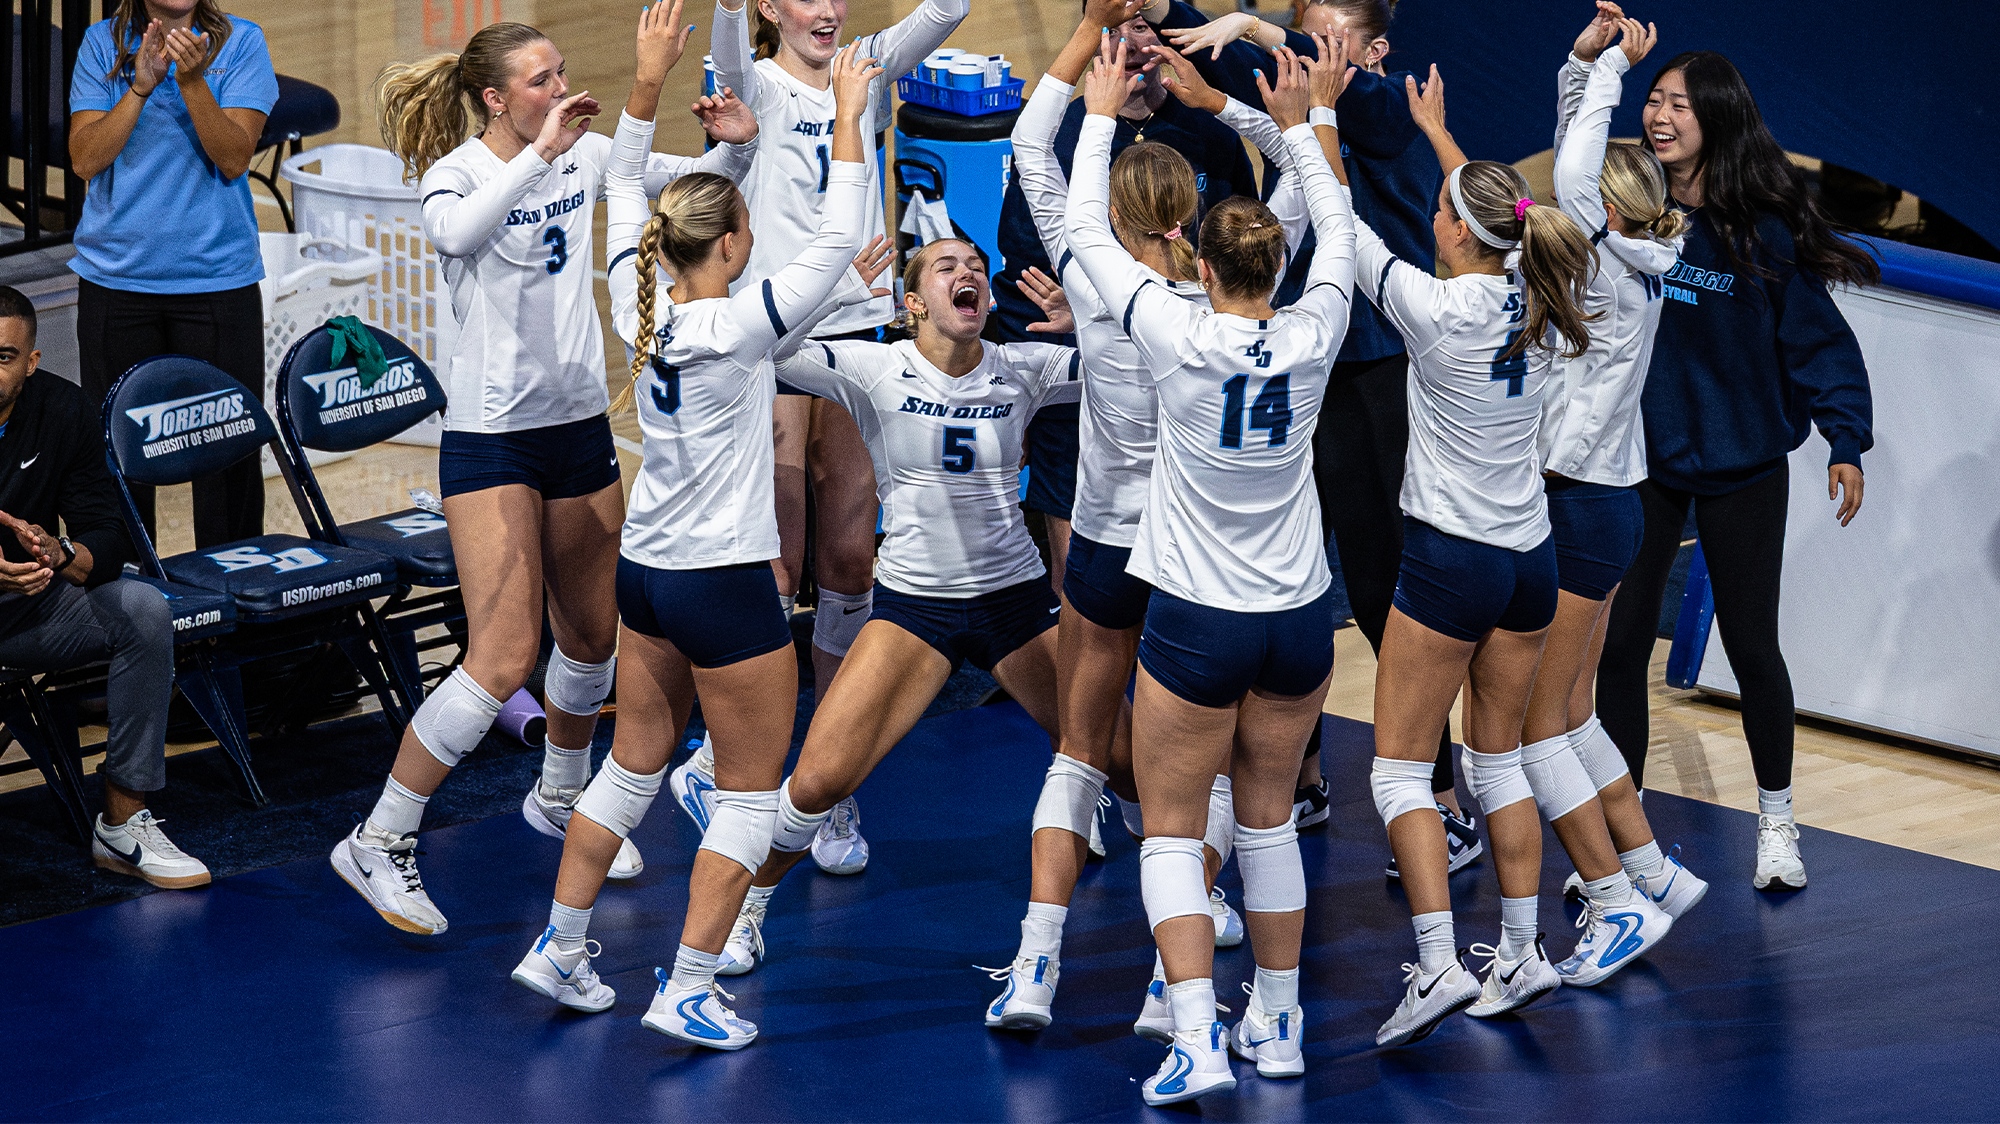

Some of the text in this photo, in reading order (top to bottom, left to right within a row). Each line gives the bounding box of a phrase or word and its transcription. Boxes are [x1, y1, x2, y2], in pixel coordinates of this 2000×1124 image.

[504, 189, 584, 227] SAN DIEGO
[543, 224, 568, 275] 3
[1662, 259, 1734, 292] DIEGO
[1243, 339, 1272, 368] SD
[1490, 328, 1528, 398] 4
[302, 356, 416, 409] TORROS
[125, 387, 244, 442] TOREROS
[319, 386, 427, 425] UNIVERSITY OF SAN DIEGO
[898, 395, 1014, 419] SAN DIEGO
[1219, 372, 1293, 450] 14
[142, 417, 256, 459] UNIVERSITY OF SAN DIEGO
[942, 425, 976, 475] 5
[203, 546, 328, 574] SD
[282, 571, 382, 607] USDToreros.com
